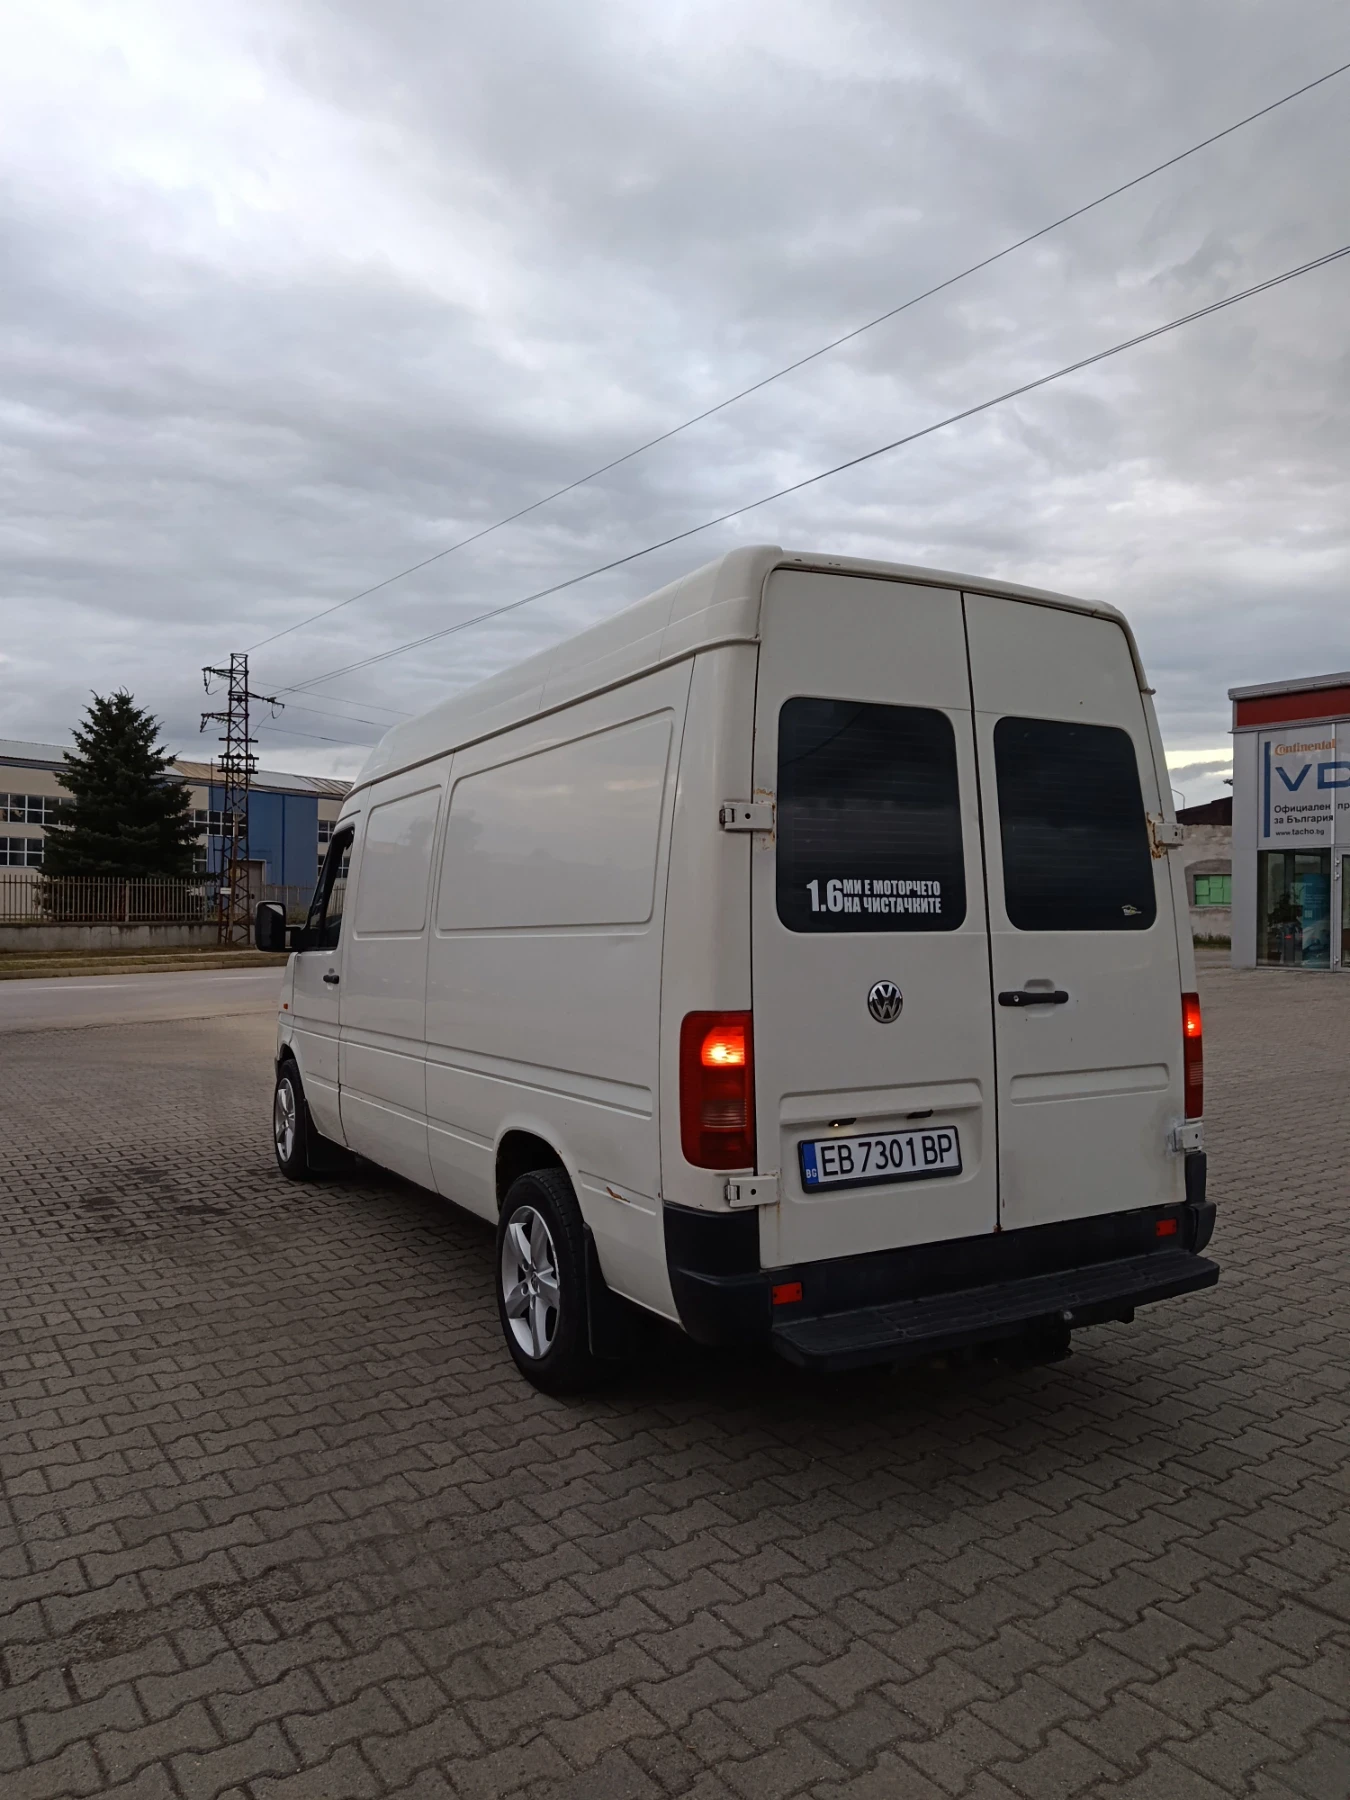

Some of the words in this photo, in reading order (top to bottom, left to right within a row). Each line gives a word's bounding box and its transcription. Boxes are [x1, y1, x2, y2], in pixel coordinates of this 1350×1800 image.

[1275, 739, 1336, 755] Continental
[1274, 804, 1331, 814] Официален
[1337, 802, 1350, 810] пр
[1287, 814, 1334, 824] България
[1276, 828, 1325, 836] www.tacho.bg
[843, 879, 862, 894] МИ
[873, 880, 941, 896] МОТОРЧЕТО
[806, 879, 844, 912] 1.6
[844, 897, 861, 913] НА
[863, 897, 942, 913] ЧИСТАЧКИТЕ
[806, 1168, 817, 1179] BG
